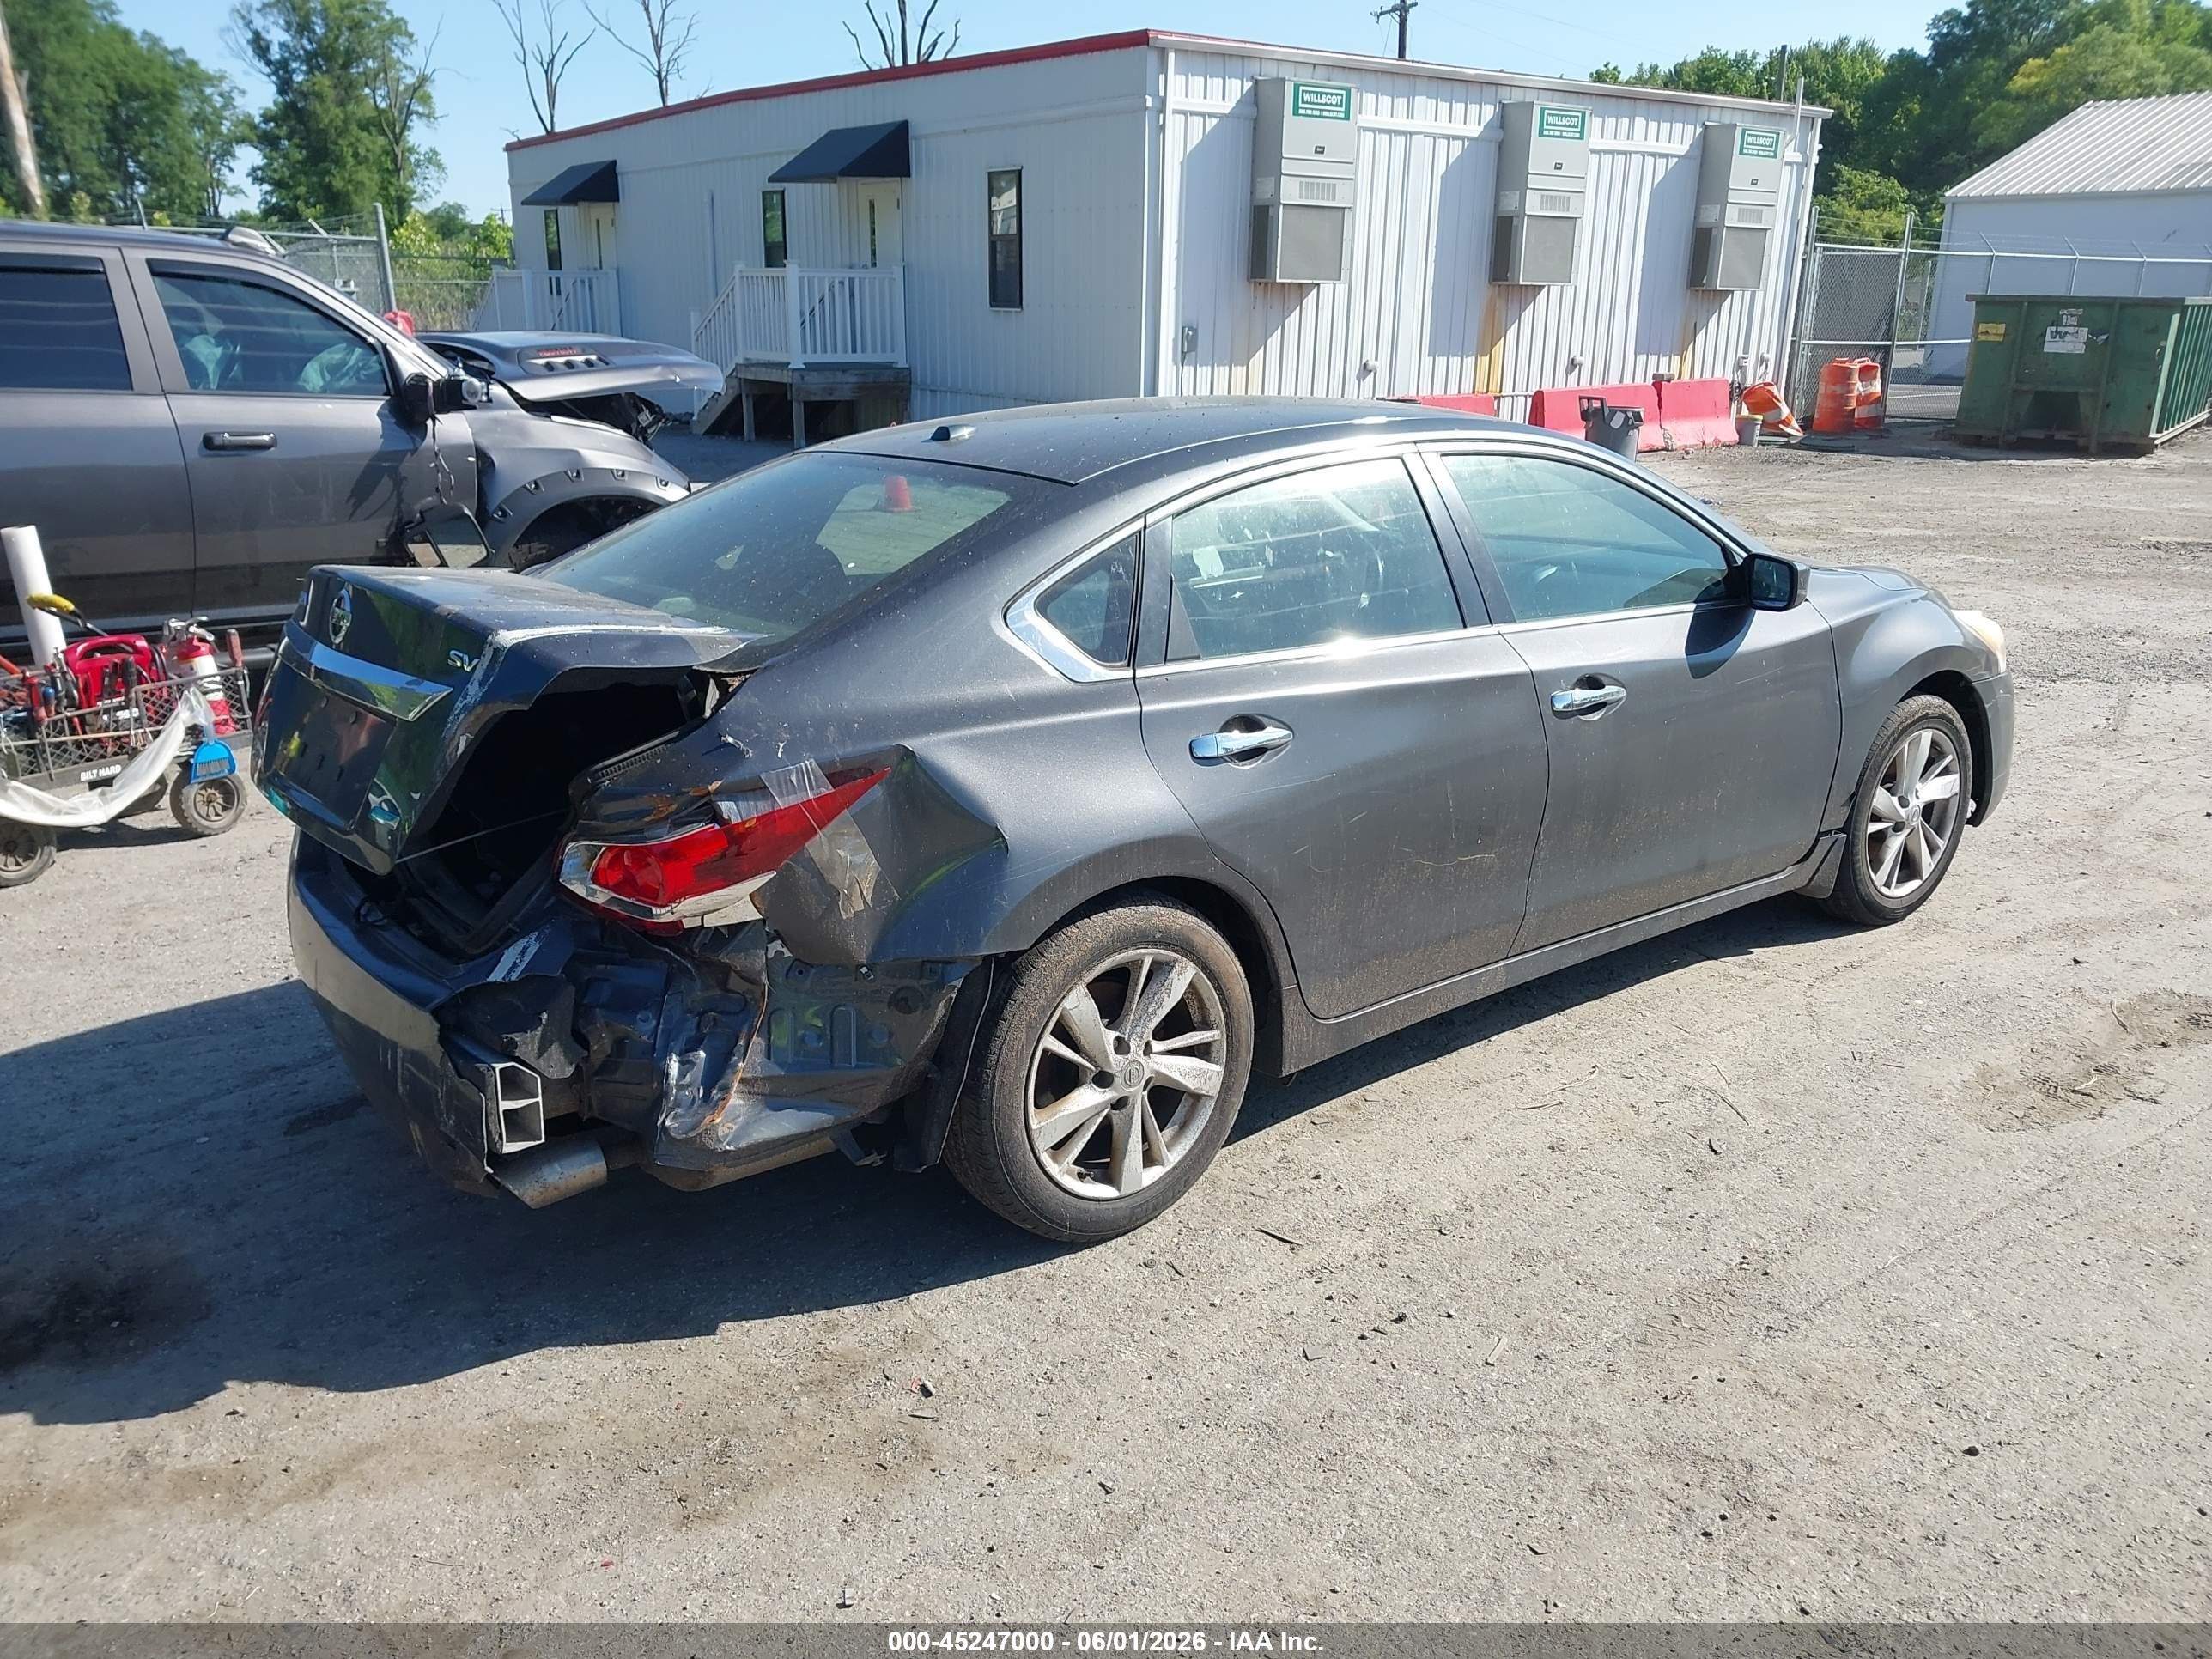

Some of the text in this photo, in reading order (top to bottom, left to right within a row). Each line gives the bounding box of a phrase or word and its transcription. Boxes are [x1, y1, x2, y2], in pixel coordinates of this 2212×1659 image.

[1304, 92, 1342, 105] WILLSCOT
[1547, 114, 1578, 126] WILLSCOT
[1747, 135, 1773, 146] WILLSCOT
[447, 650, 480, 672] SV
[81, 769, 98, 781] BILT
